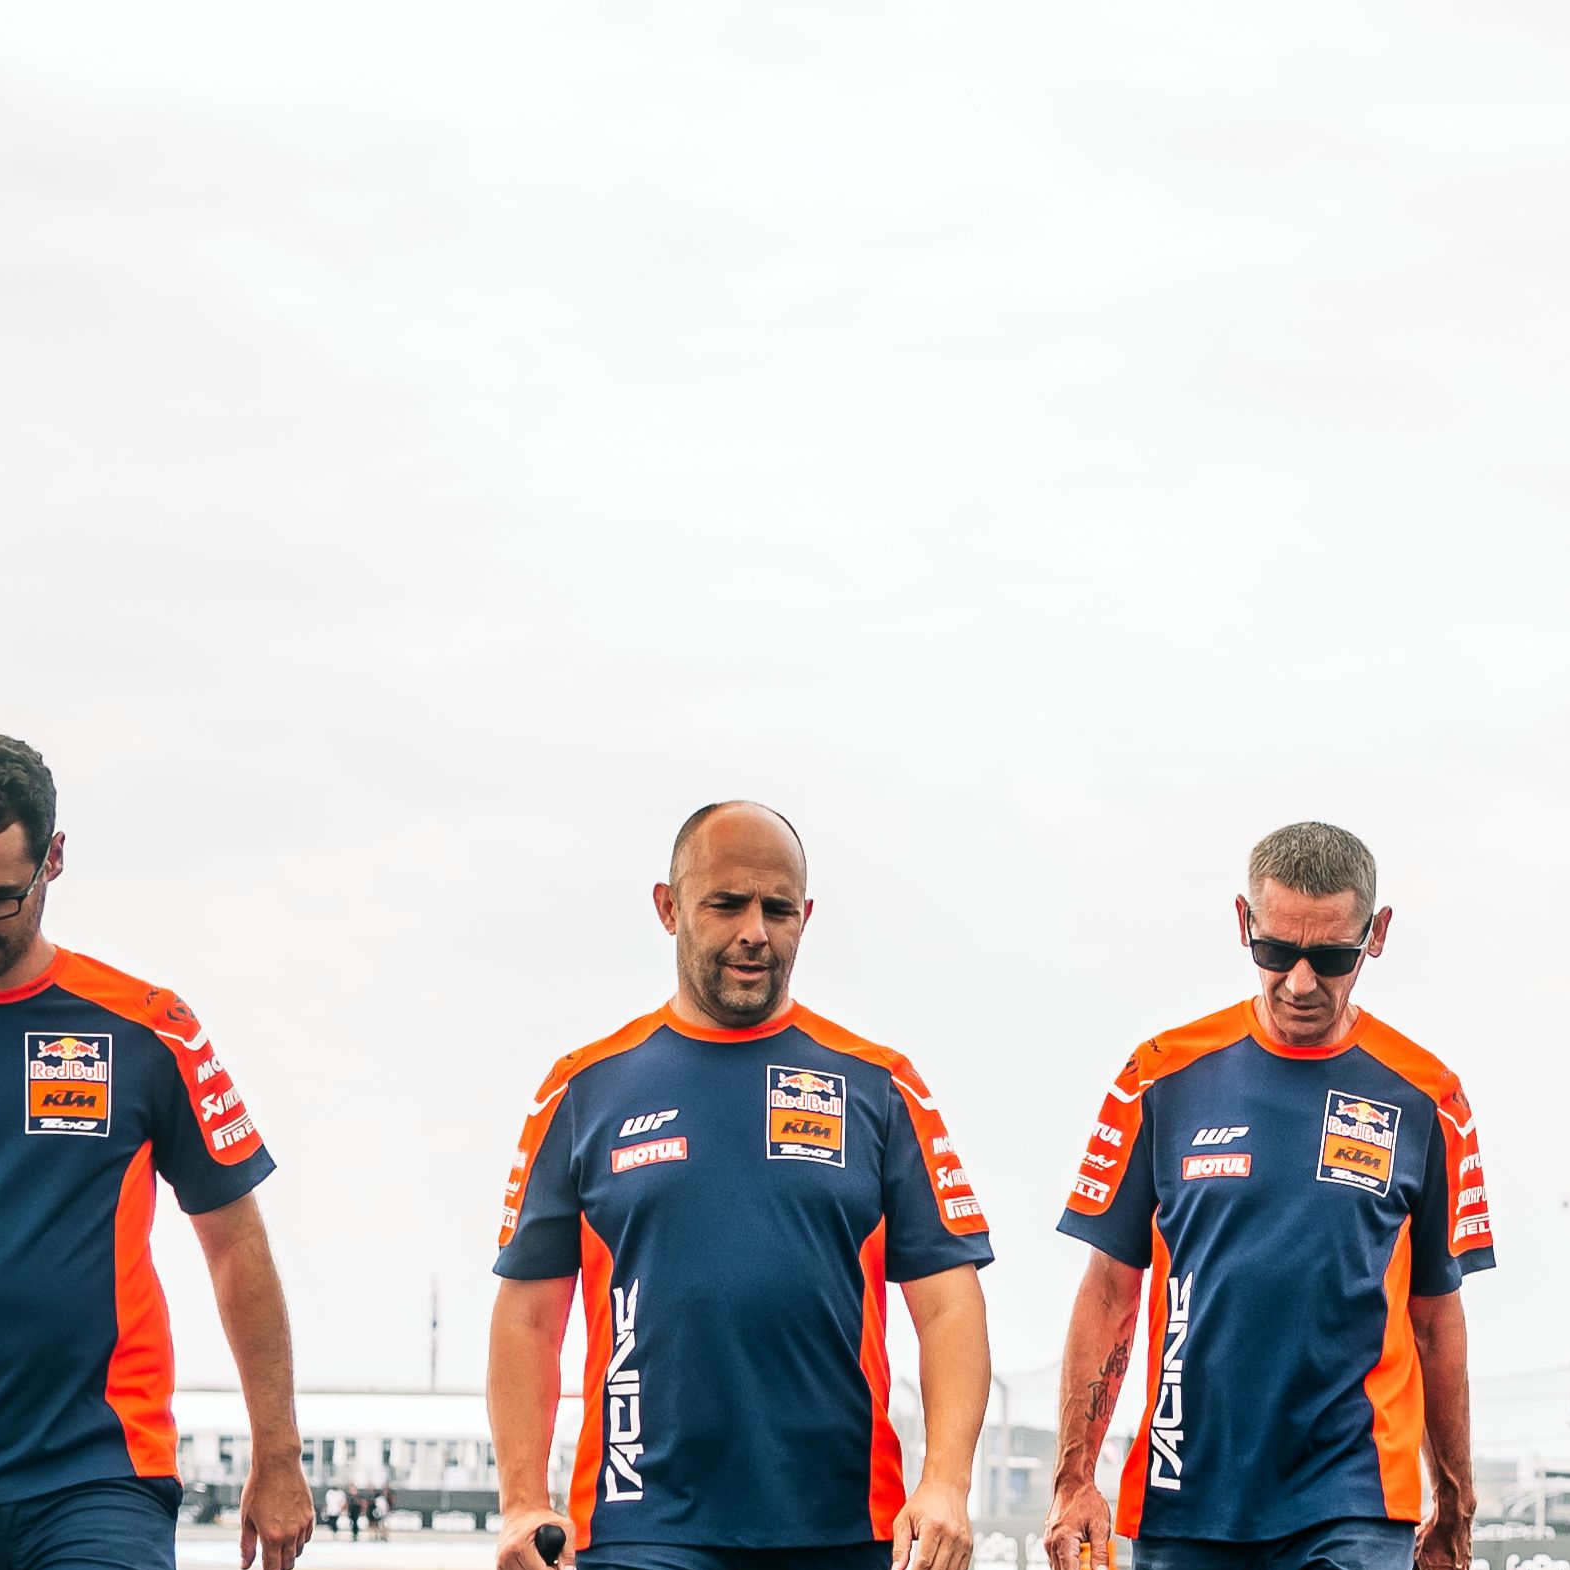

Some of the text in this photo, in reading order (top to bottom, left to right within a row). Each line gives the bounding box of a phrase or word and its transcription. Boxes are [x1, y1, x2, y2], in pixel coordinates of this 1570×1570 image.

[30, 1060, 107, 1081] Red Bull
[41, 1090, 97, 1109] KTM
[771, 1089, 841, 1116] Red Bull
[211, 1112, 256, 1151] PIRE
[619, 1108, 679, 1138] WP
[780, 1118, 833, 1140] KTM
[1092, 1121, 1123, 1148] TUL
[1329, 1115, 1393, 1149] Red Bull
[1191, 1126, 1249, 1146] WP
[616, 1142, 683, 1170] MOTUL
[1185, 1156, 1247, 1177] MOTUL
[1334, 1146, 1381, 1170] KTM
[944, 1196, 981, 1220] PIRE
